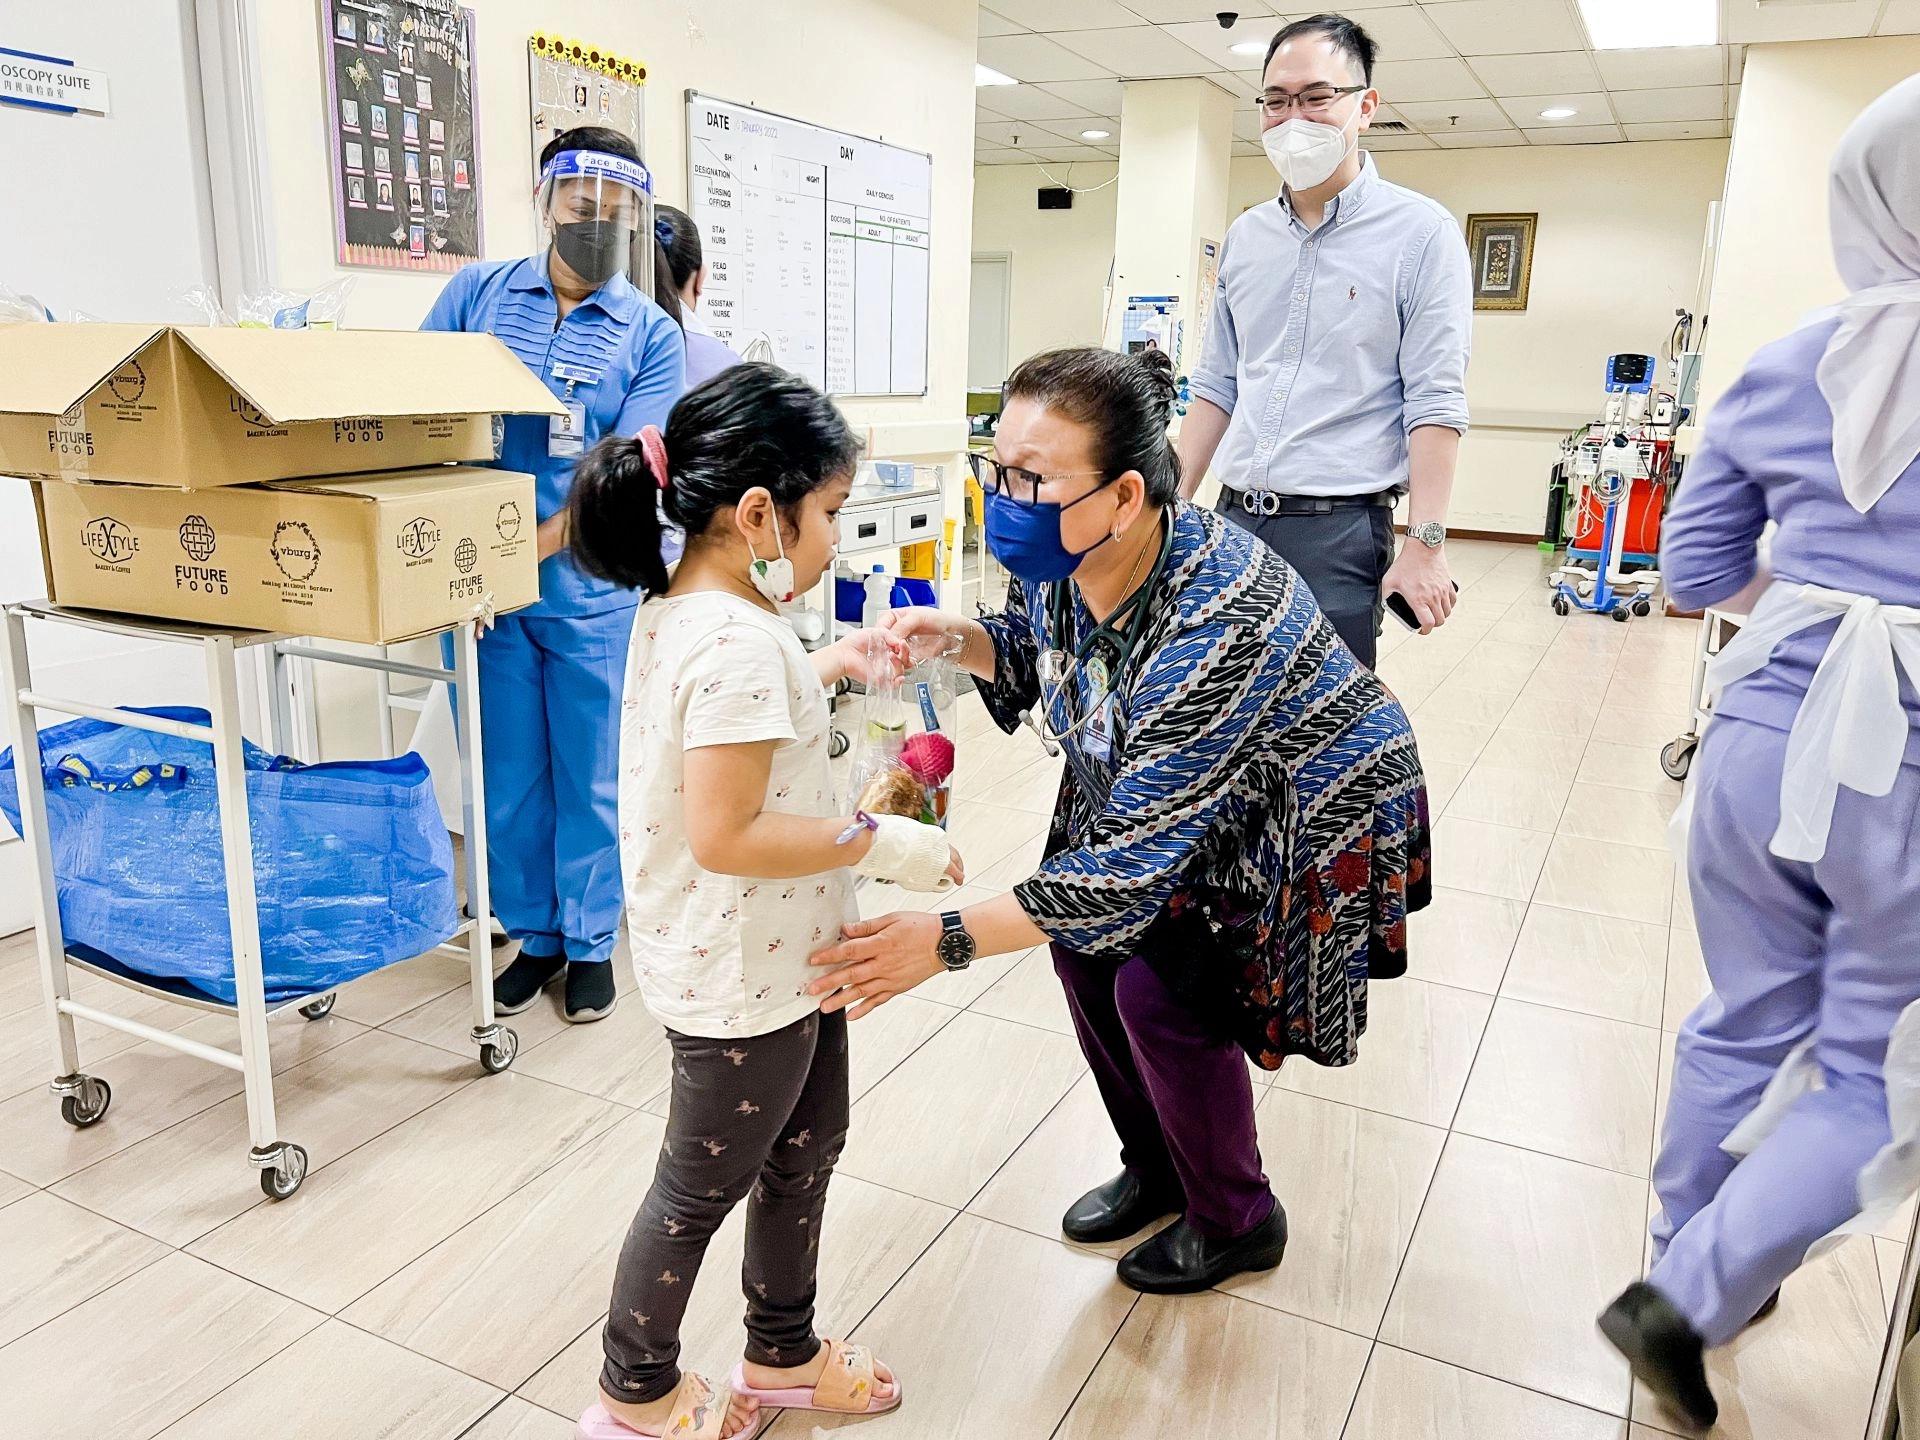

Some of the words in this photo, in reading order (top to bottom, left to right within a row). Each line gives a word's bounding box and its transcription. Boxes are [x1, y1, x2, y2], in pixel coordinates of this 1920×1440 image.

[423, 41, 453, 66] NURSE
[1, 64, 53, 83] OSCOPY
[57, 74, 91, 90] SUITE
[707, 111, 730, 130] DATE
[840, 146, 854, 160] DAY
[616, 162, 645, 179] Shield
[694, 164, 731, 179] DESIGNATION
[708, 186, 732, 198] NURSING
[866, 188, 878, 198] DAILY
[709, 198, 731, 208] OFFICER
[830, 214, 852, 225] DOCTORS
[868, 228, 881, 237] ADULT
[707, 299, 735, 308] ASSISTAN
[713, 310, 731, 318] NURSE
[713, 330, 733, 339] EALTH
[334, 420, 383, 431] FUTURE
[48, 430, 93, 445] FUTURE
[335, 431, 384, 443] FOOD
[50, 443, 94, 456] FOOD
[280, 546, 311, 560] vburg
[175, 565, 228, 583] FUTURE
[176, 579, 229, 595] FOOD
[449, 574, 483, 591] FUTURE
[450, 585, 483, 600] FOOD
